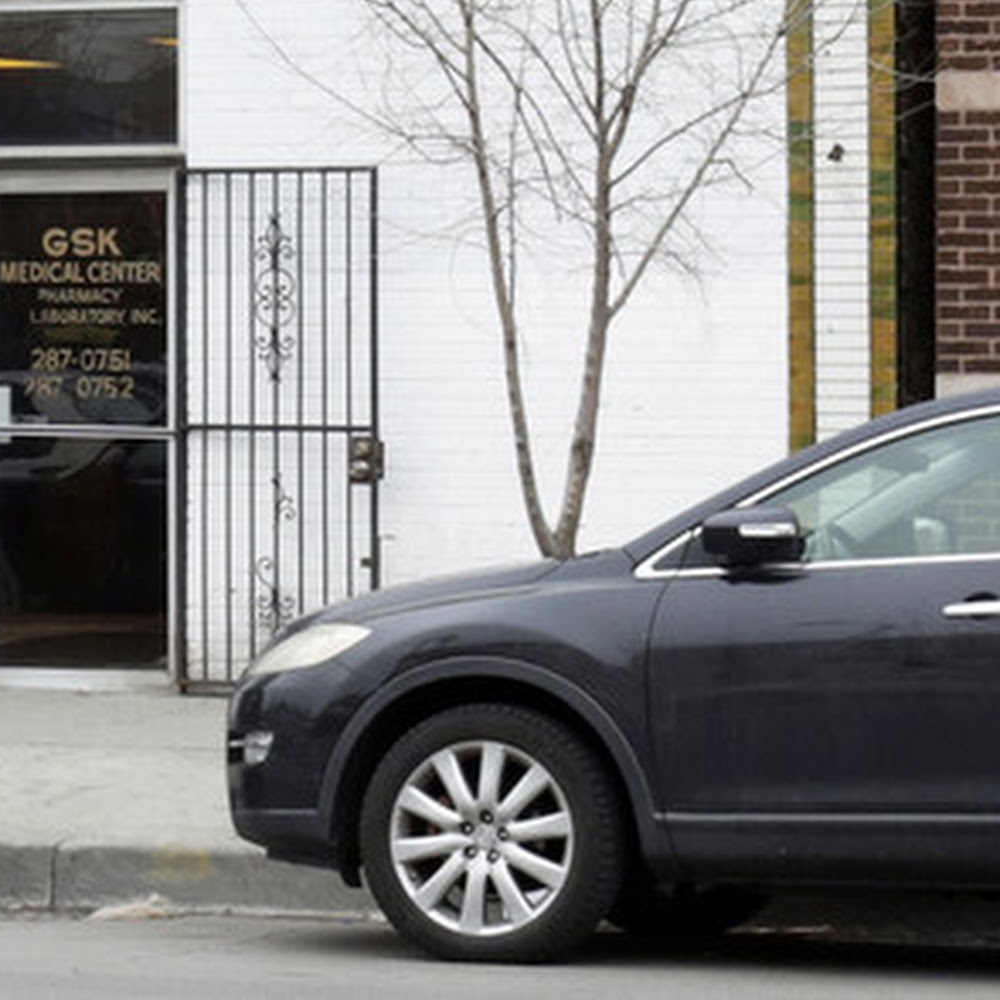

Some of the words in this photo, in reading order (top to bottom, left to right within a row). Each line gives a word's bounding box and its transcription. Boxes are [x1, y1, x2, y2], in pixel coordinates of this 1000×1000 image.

[42, 227, 122, 257] GSK
[0, 262, 84, 283] MEDICAL
[87, 260, 161, 283] CENTER
[37, 287, 123, 304] PHARMACY
[31, 348, 131, 372] 287-0751
